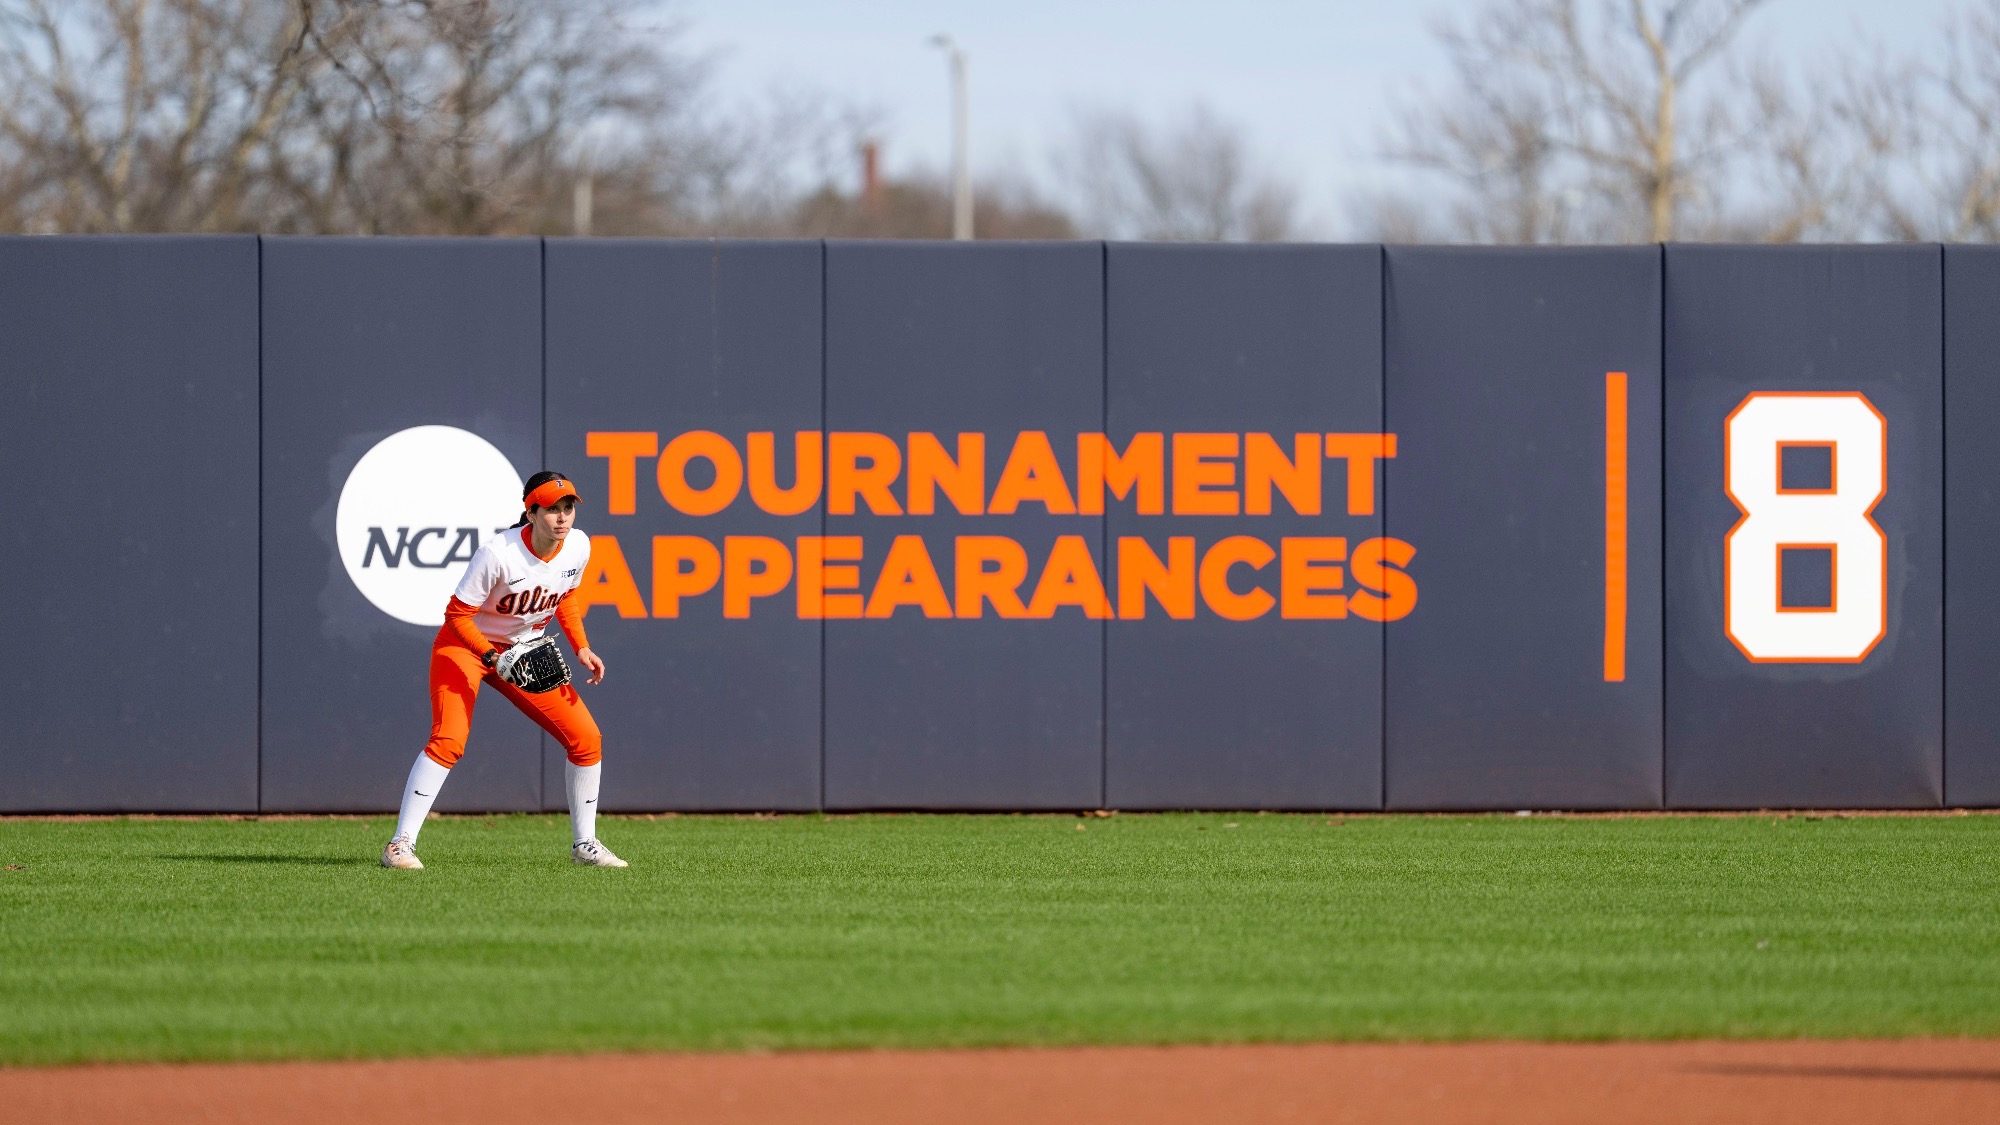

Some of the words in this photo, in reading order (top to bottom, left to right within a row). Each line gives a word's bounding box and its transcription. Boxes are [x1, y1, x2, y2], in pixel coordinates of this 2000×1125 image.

[586, 430, 1397, 516] TOURNAMENT
[362, 526, 511, 568] NCA
[1725, 391, 1887, 663] 8
[578, 535, 1418, 622] APPEARANCES
